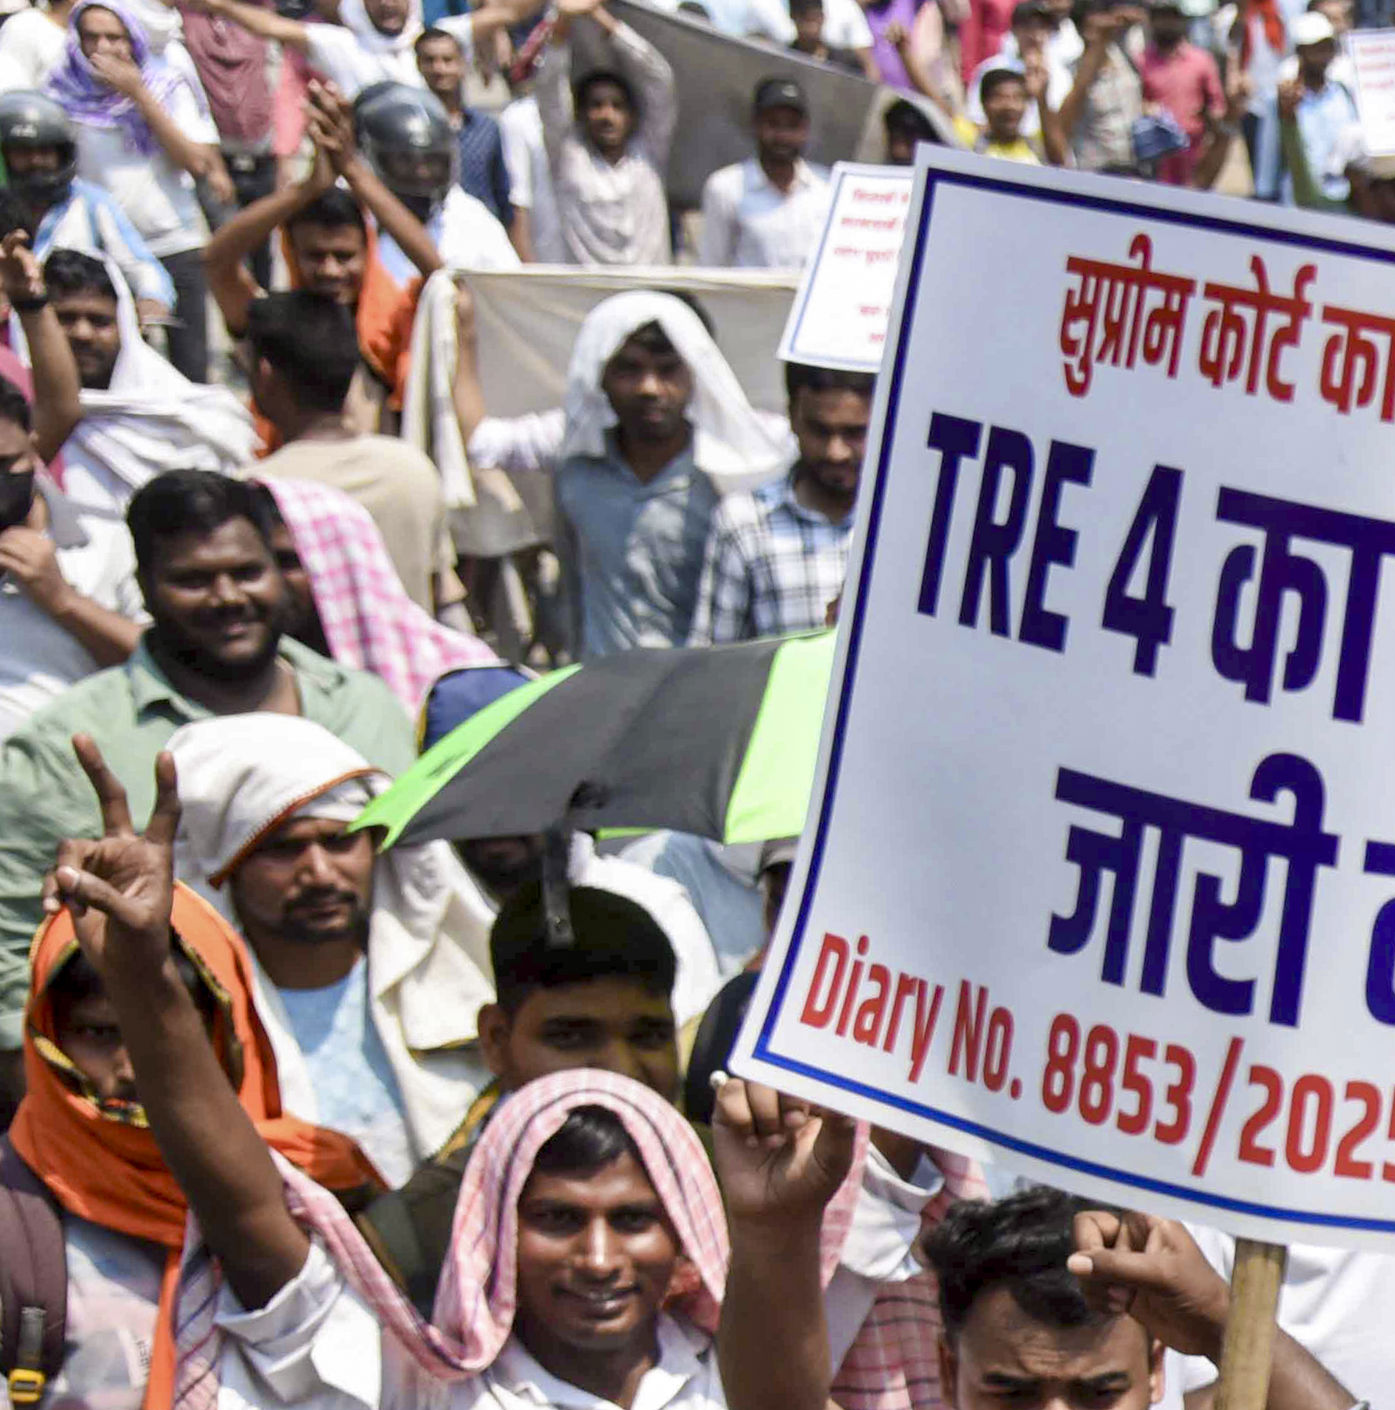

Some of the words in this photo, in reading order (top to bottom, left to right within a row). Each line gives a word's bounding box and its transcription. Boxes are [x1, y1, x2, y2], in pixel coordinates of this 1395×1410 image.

[1059, 233, 1197, 397] सुप्रीम
[1197, 254, 1318, 401] कोर्ट
[914, 410, 1098, 655] TRE
[1100, 462, 1184, 679] 4
[1046, 752, 1341, 1029] जारी
[799, 932, 943, 1084] Diary
[947, 980, 1023, 1100] No.
